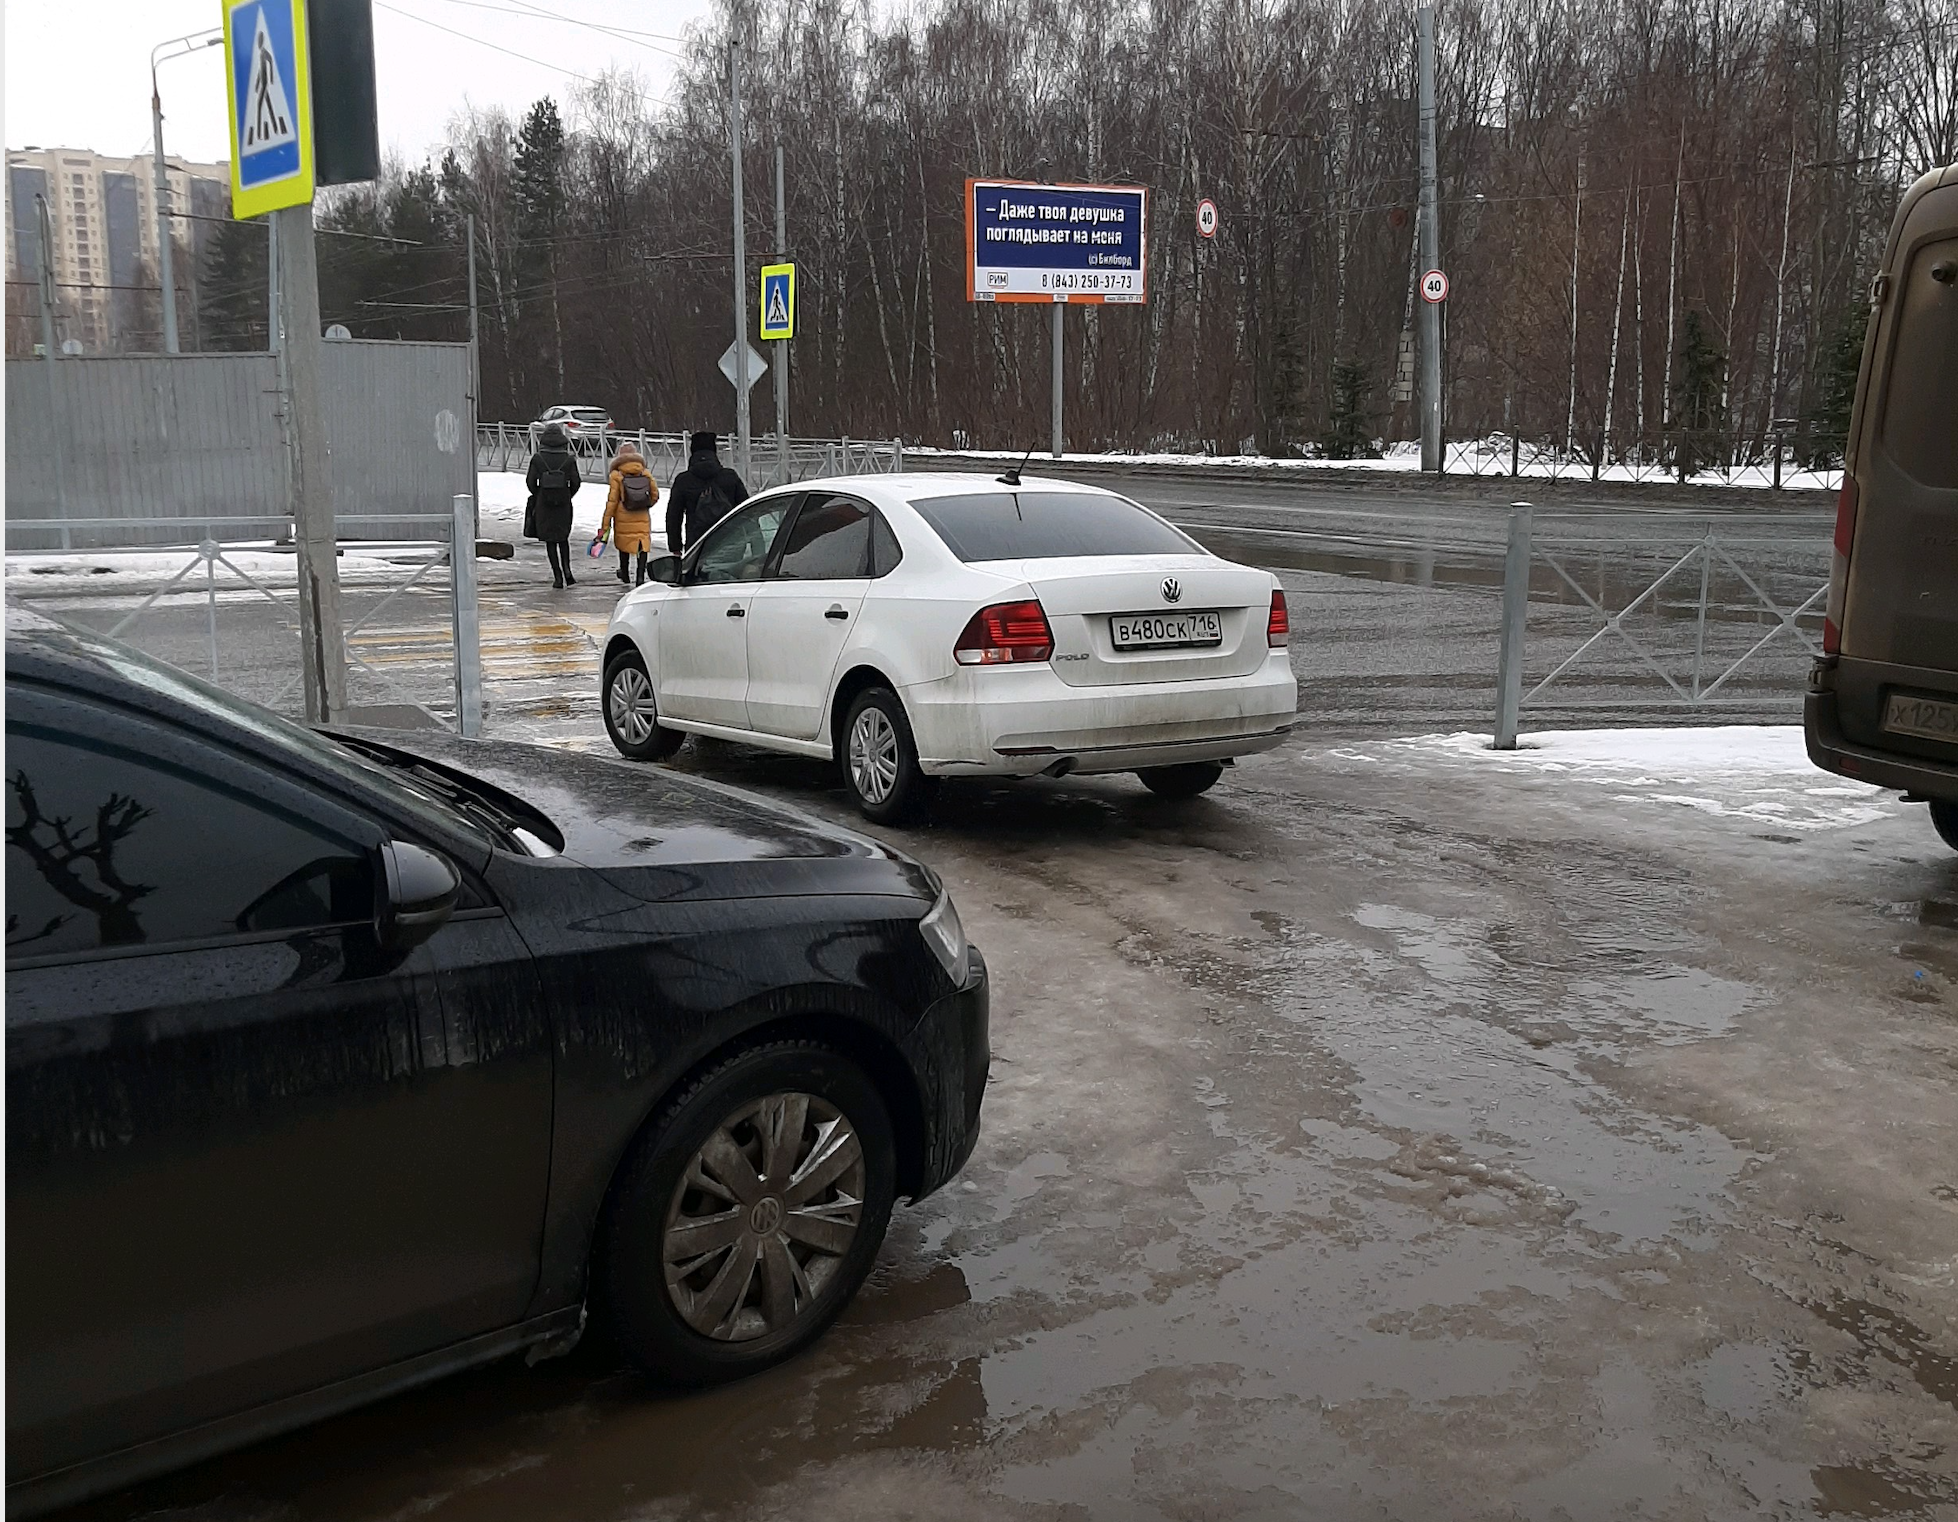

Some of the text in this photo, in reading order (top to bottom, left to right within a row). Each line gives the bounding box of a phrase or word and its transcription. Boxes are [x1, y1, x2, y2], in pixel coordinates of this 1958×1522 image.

[999, 199, 1035, 221] Даже
[1038, 205, 1067, 220] твоя
[1070, 208, 1125, 226] девушка
[1202, 211, 1213, 225] 40
[986, 227, 1122, 245] поглядывает на меня
[989, 274, 1007, 285] РИМ
[1042, 273, 1132, 289] 8 (843) 250-37-73
[1427, 280, 1441, 292] 40
[1055, 653, 1089, 662] POLO
